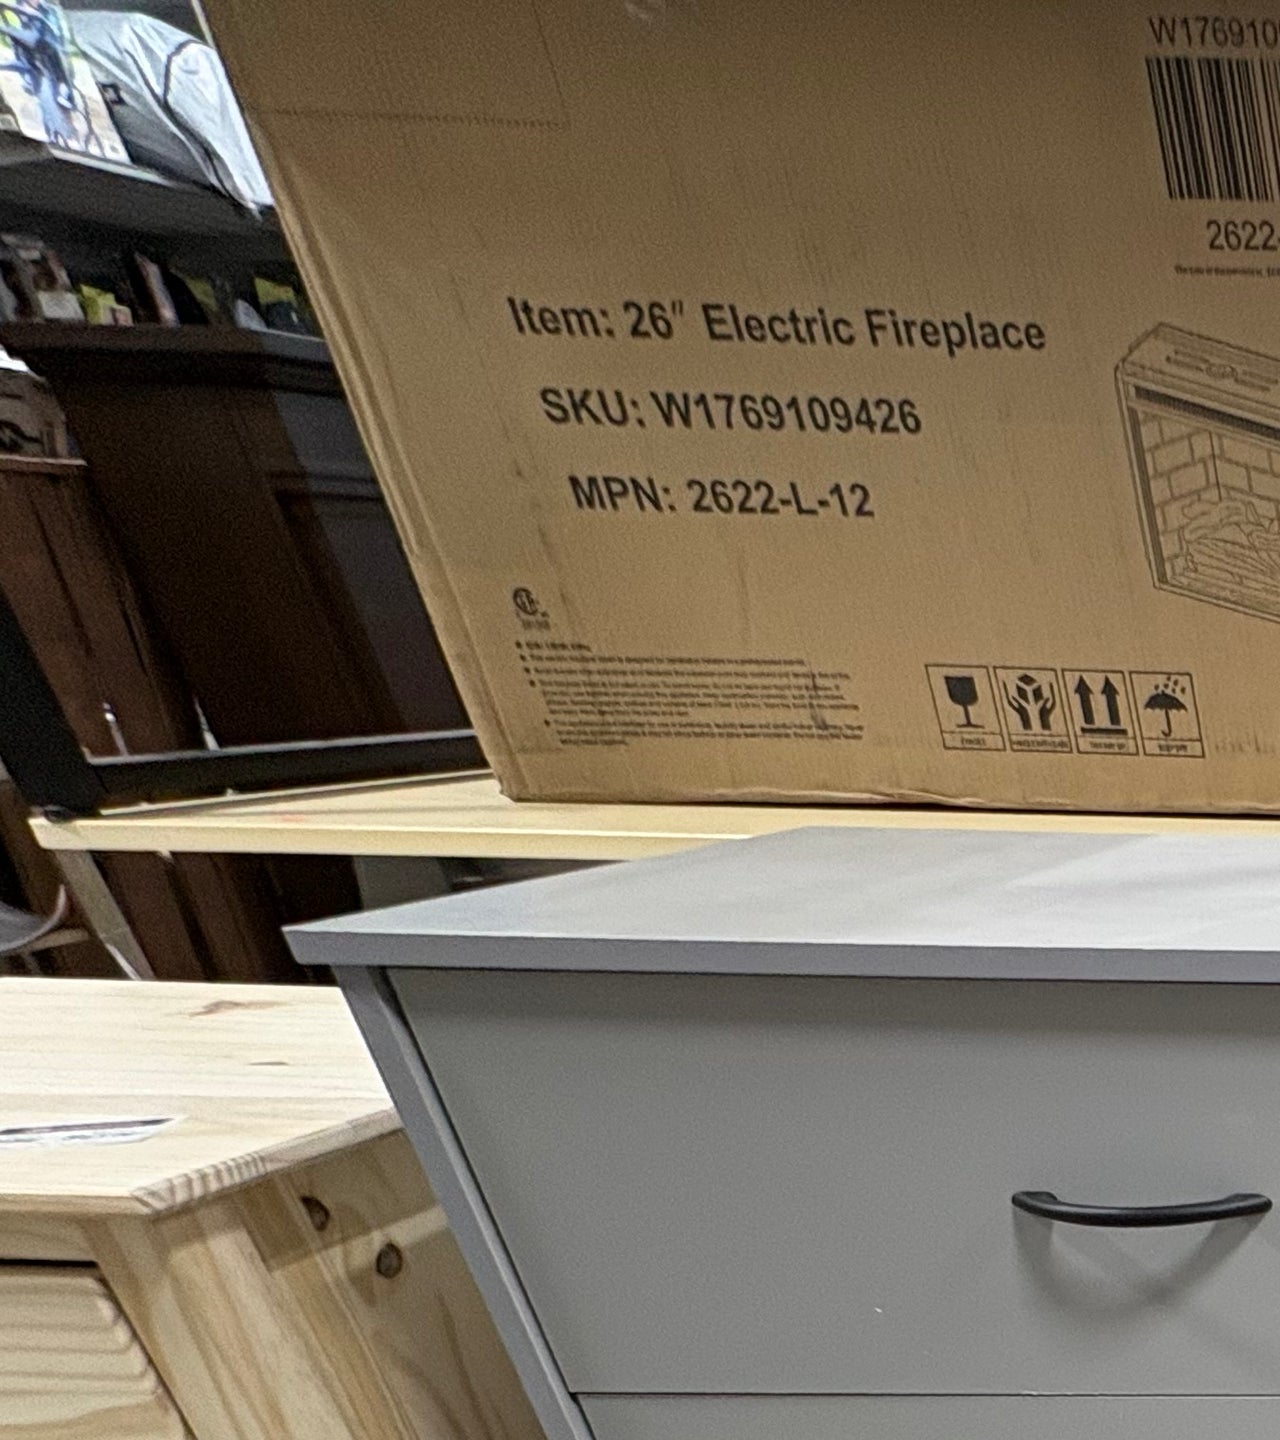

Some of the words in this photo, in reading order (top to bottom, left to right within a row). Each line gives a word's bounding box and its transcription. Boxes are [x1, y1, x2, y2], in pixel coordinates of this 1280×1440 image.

[508, 297, 615, 338] Item:
[623, 300, 684, 340] 26"
[702, 303, 856, 347] Electric
[865, 308, 1046, 357] Fireplace
[540, 387, 646, 428] SKU:
[650, 392, 922, 434] W1769109426
[568, 475, 676, 513] MPN:
[686, 478, 876, 518] 2622-L-12
